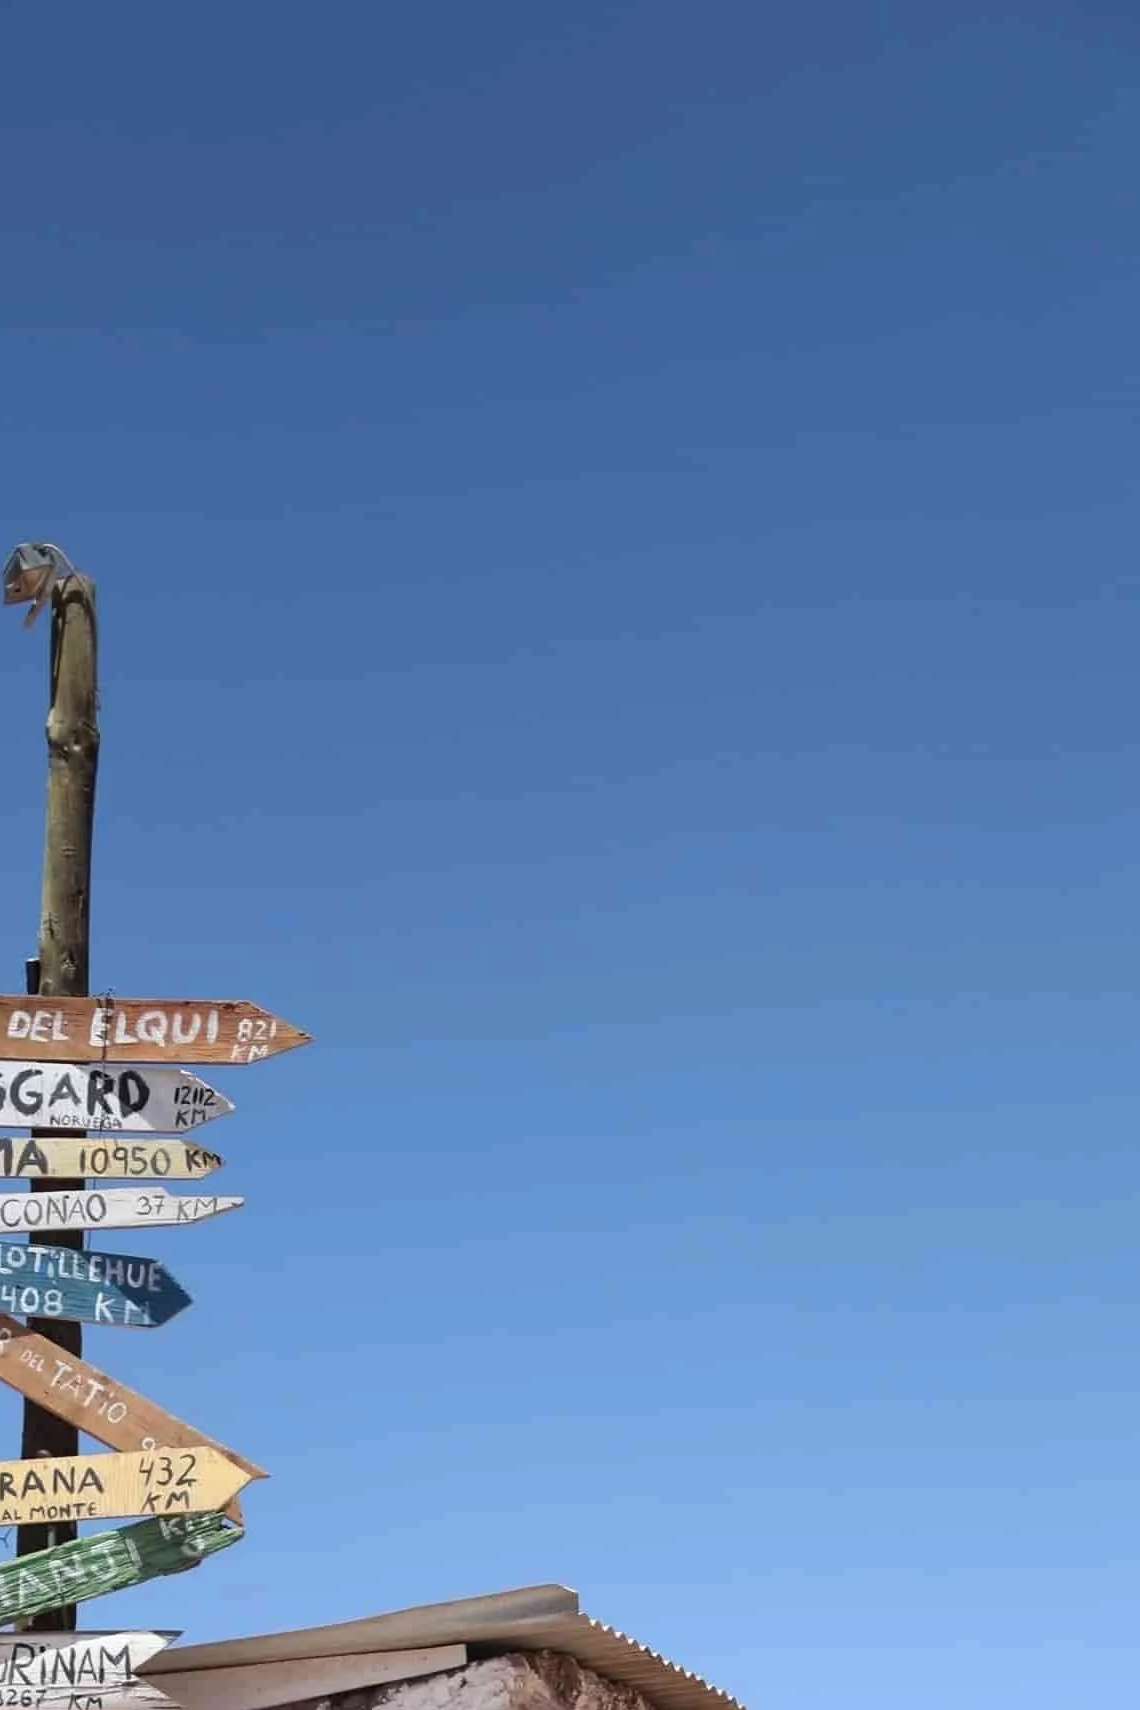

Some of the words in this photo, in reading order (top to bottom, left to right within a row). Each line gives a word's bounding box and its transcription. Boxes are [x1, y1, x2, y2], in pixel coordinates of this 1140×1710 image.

[7, 1009, 69, 1042] DEL
[88, 1007, 220, 1047] ELQUI
[236, 1018, 276, 1044] 821
[229, 1043, 269, 1062] KM
[175, 1108, 207, 1126] KM
[78, 1147, 172, 1176] 10950
[185, 1149, 224, 1171] KM
[135, 1195, 164, 1216] 37
[177, 1198, 218, 1223] KM
[20, 1349, 45, 1372] DEL
[139, 1454, 198, 1487] 432
[1, 1508, 22, 1522] AL
[30, 1501, 97, 1521] MONTE
[142, 1491, 190, 1513] KM
